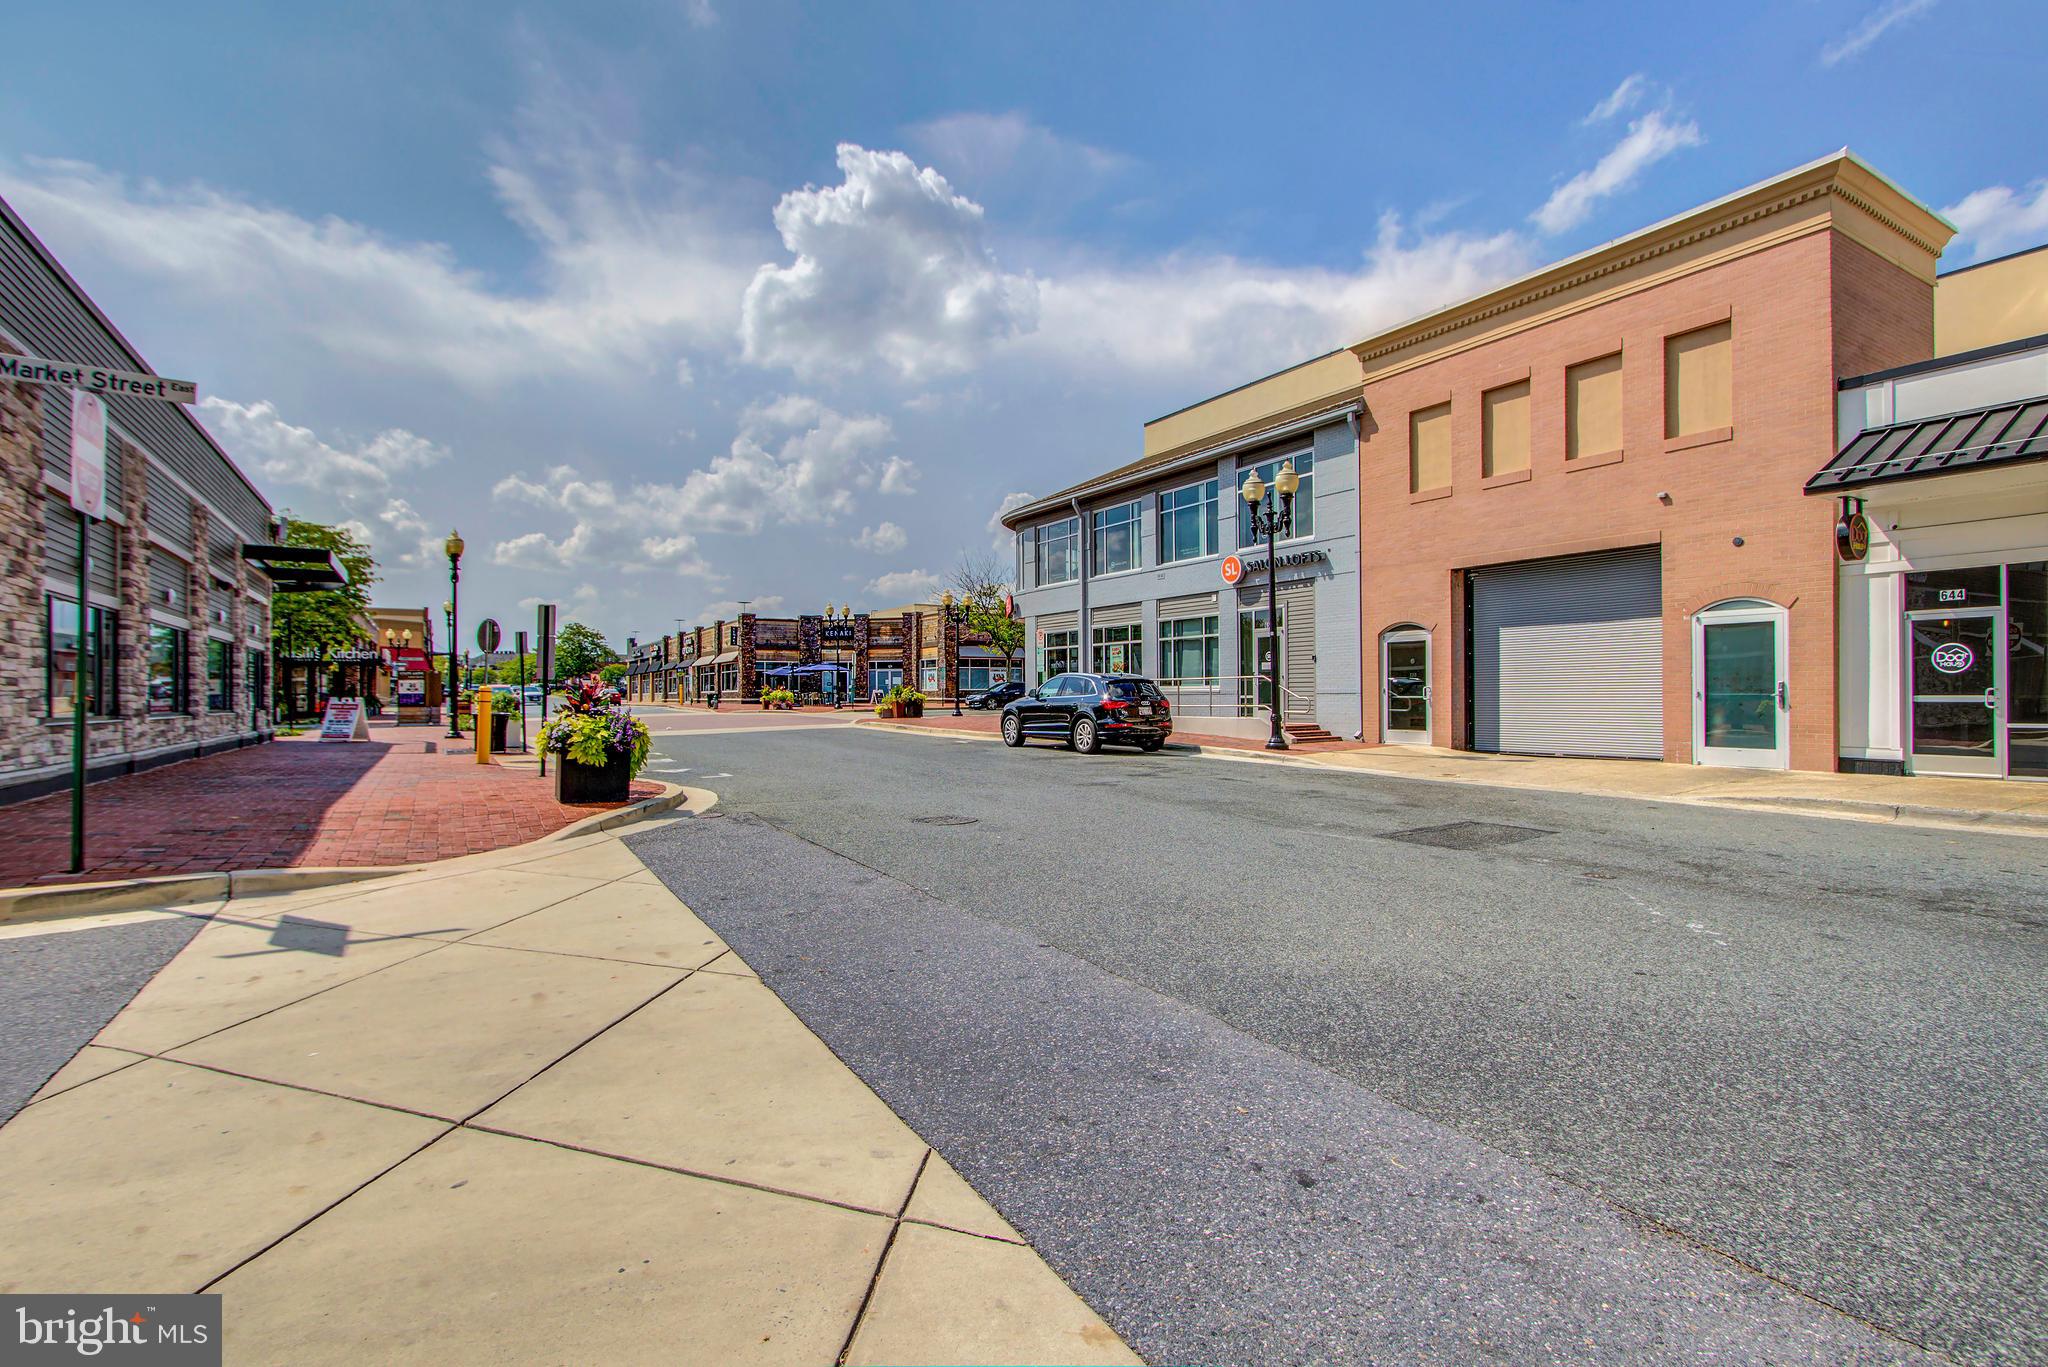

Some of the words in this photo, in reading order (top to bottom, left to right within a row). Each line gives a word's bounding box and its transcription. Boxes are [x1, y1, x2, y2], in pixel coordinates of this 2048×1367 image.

[0, 357, 83, 384] Market
[92, 372, 166, 397] Street
[171, 383, 194, 393] East
[1224, 562, 1238, 577] SL
[1941, 590, 1964, 600] 644
